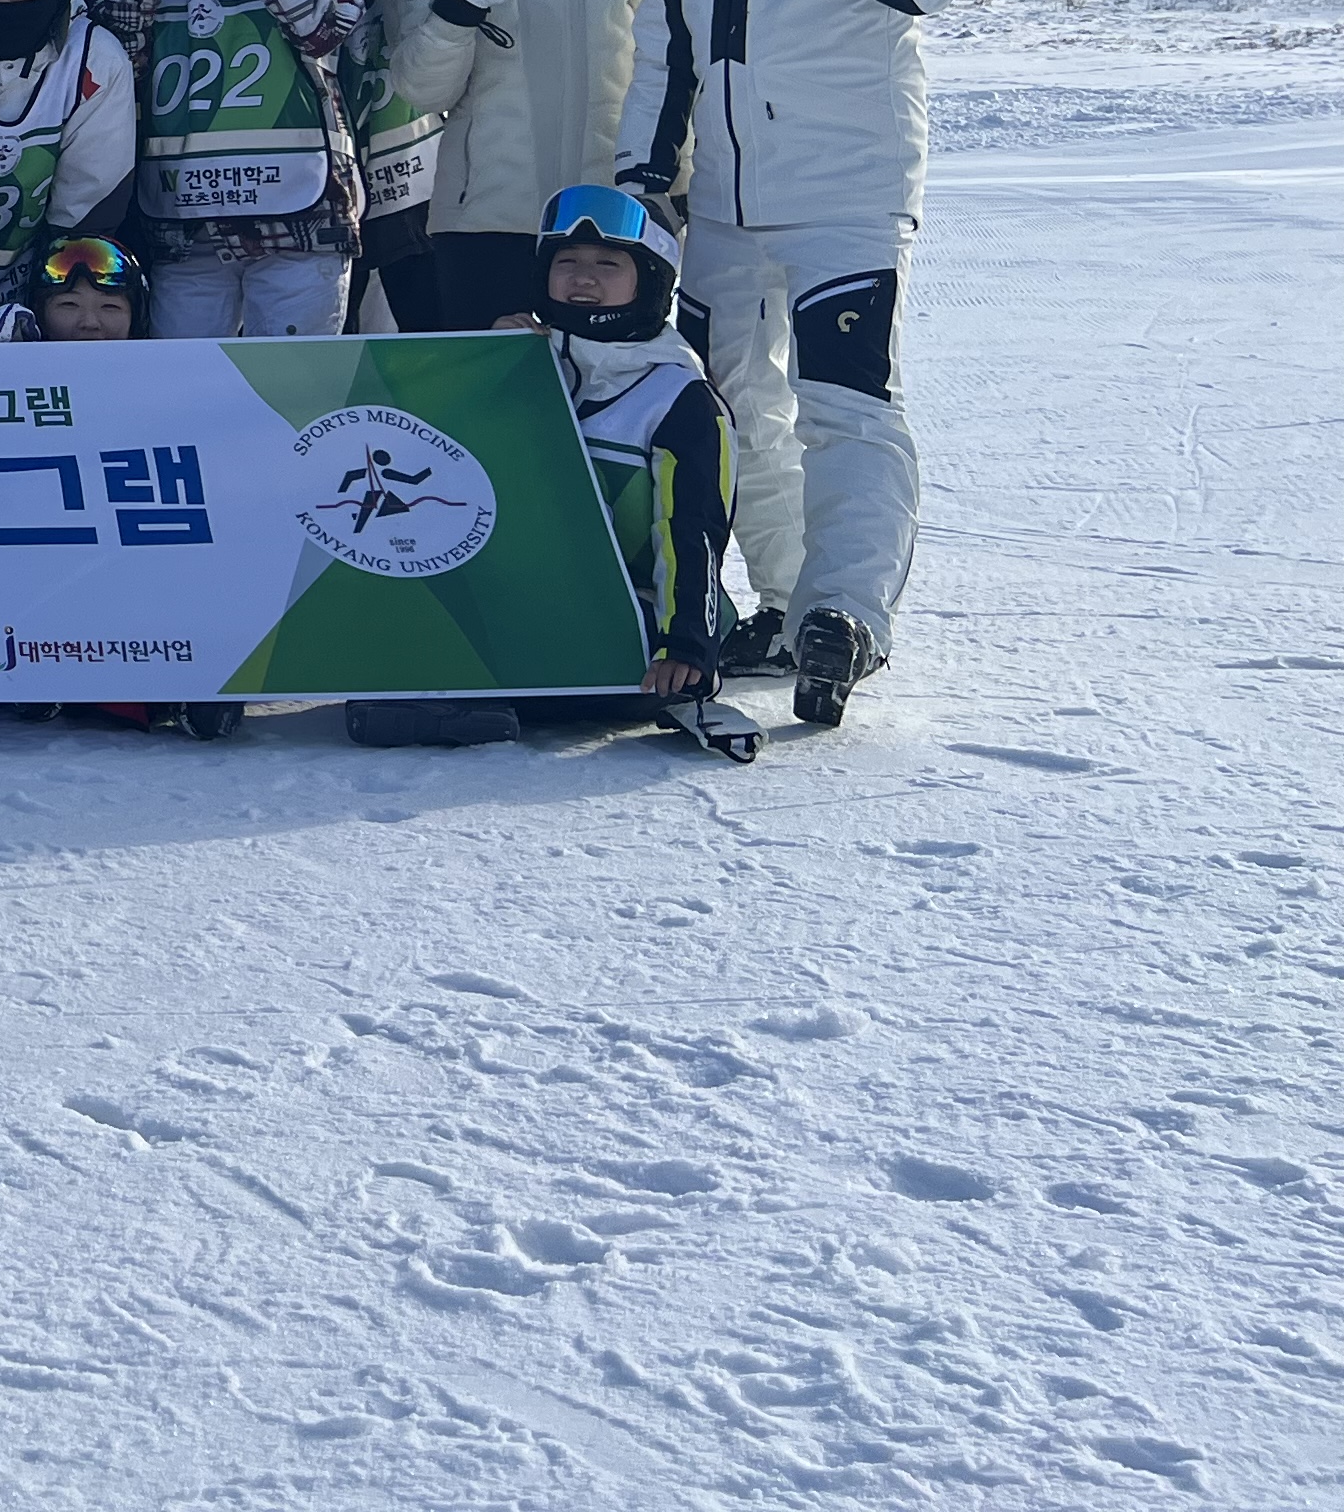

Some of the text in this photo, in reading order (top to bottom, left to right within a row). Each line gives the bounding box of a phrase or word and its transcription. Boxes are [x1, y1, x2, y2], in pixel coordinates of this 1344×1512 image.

[152, 44, 271, 116] 022
[184, 166, 281, 189] 건양대학교
[293, 409, 465, 462] SPORTS MEDICINE
[295, 506, 492, 573] KONYANG UNIVERSITY
[389, 537, 416, 546] since
[19, 640, 193, 663] 대학혁신지원사업
